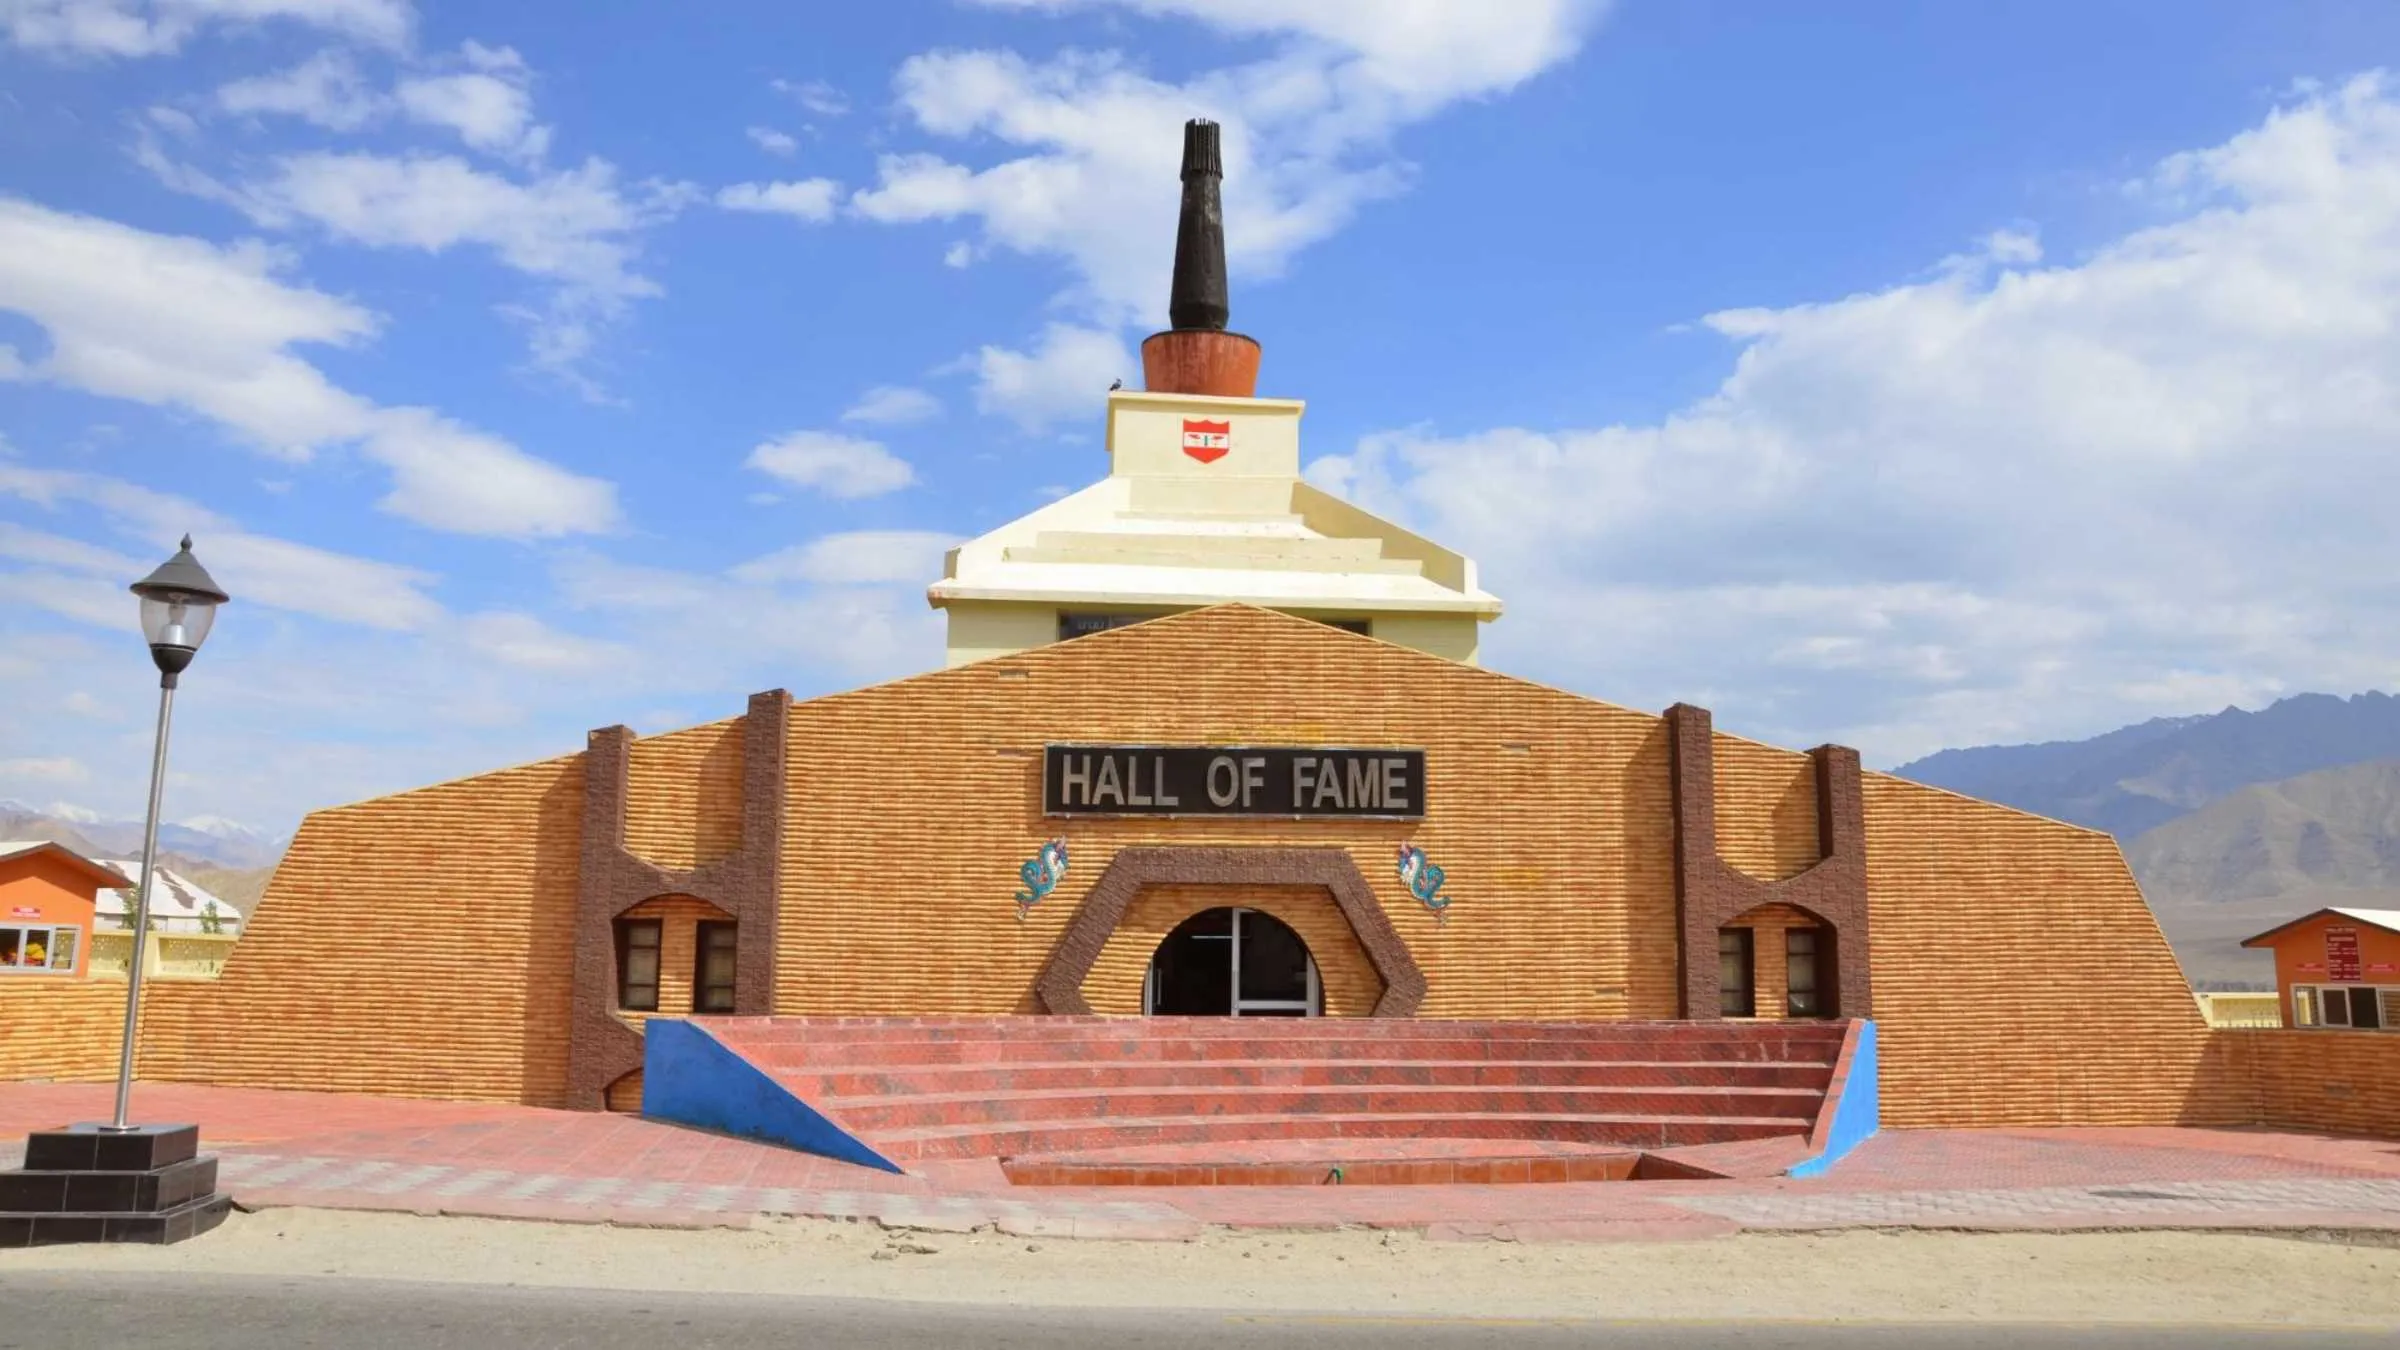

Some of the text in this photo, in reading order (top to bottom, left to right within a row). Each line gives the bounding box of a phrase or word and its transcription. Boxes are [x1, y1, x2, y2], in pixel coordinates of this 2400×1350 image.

[1062, 754, 1409, 809] HALL OF FAME
